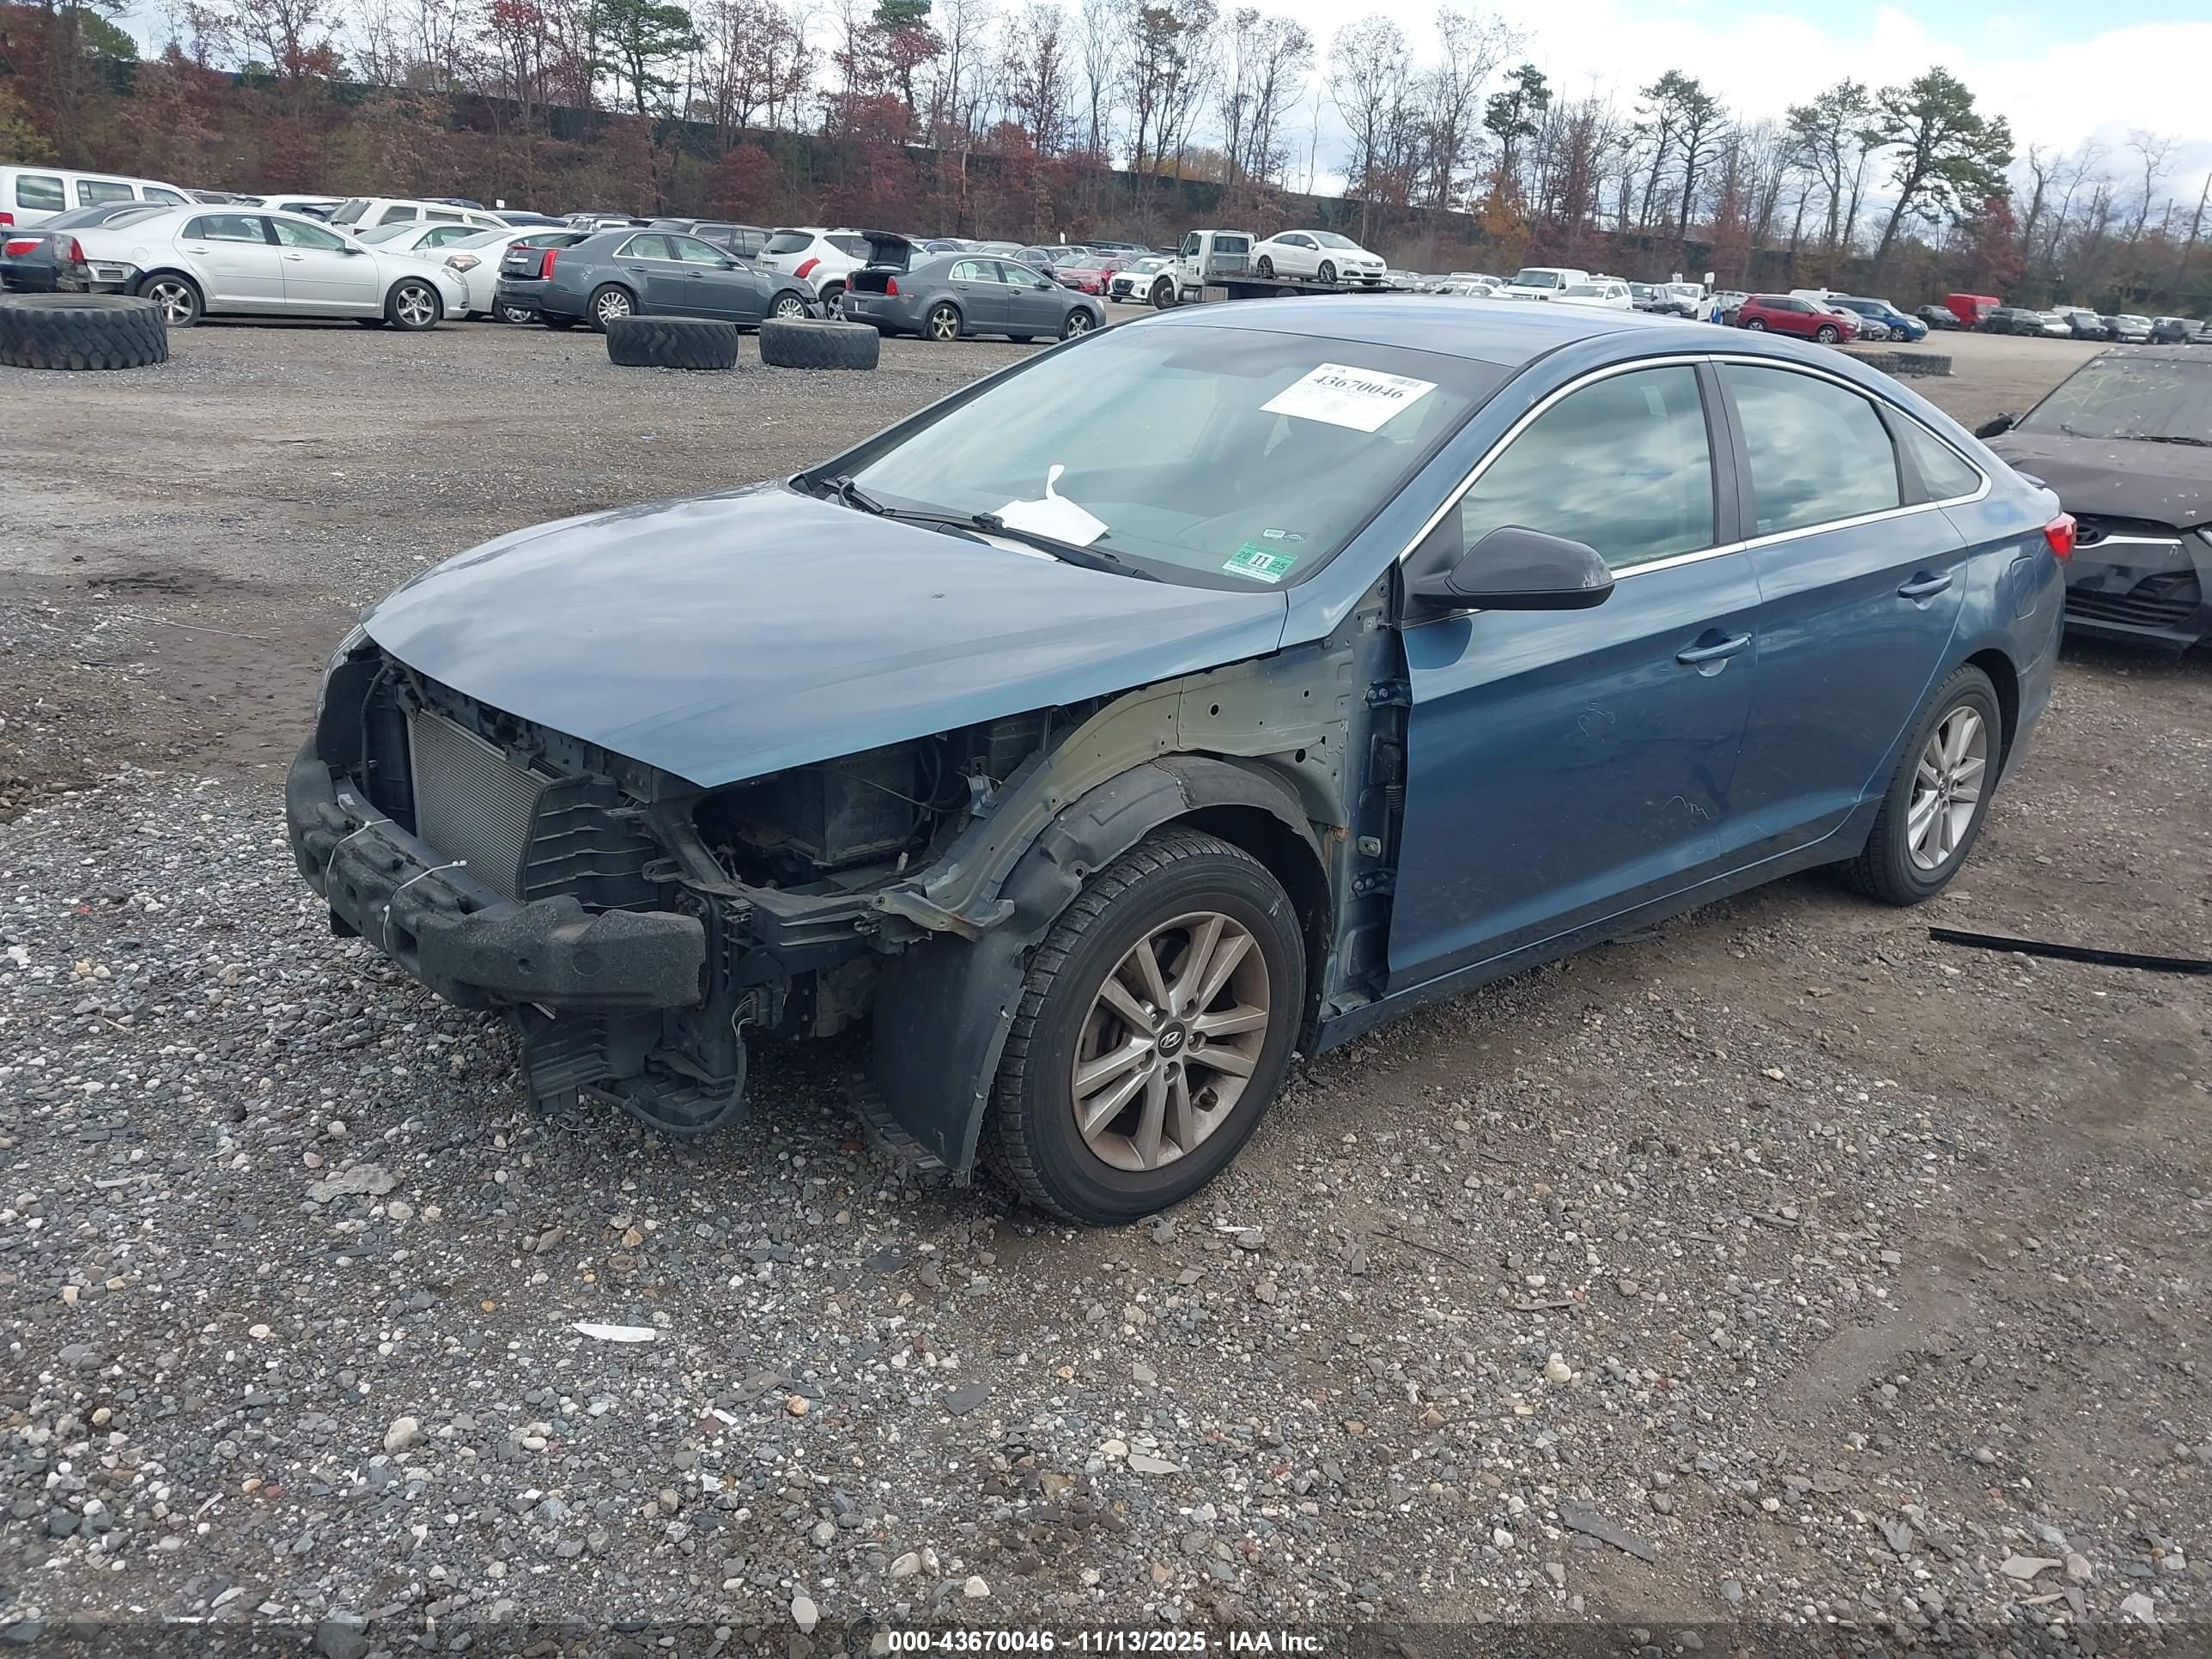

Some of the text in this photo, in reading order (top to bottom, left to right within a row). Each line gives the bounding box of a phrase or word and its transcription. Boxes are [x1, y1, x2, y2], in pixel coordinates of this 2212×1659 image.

[1313, 375, 1404, 399] 43670046
[1237, 550, 1287, 570] 20 11 25
